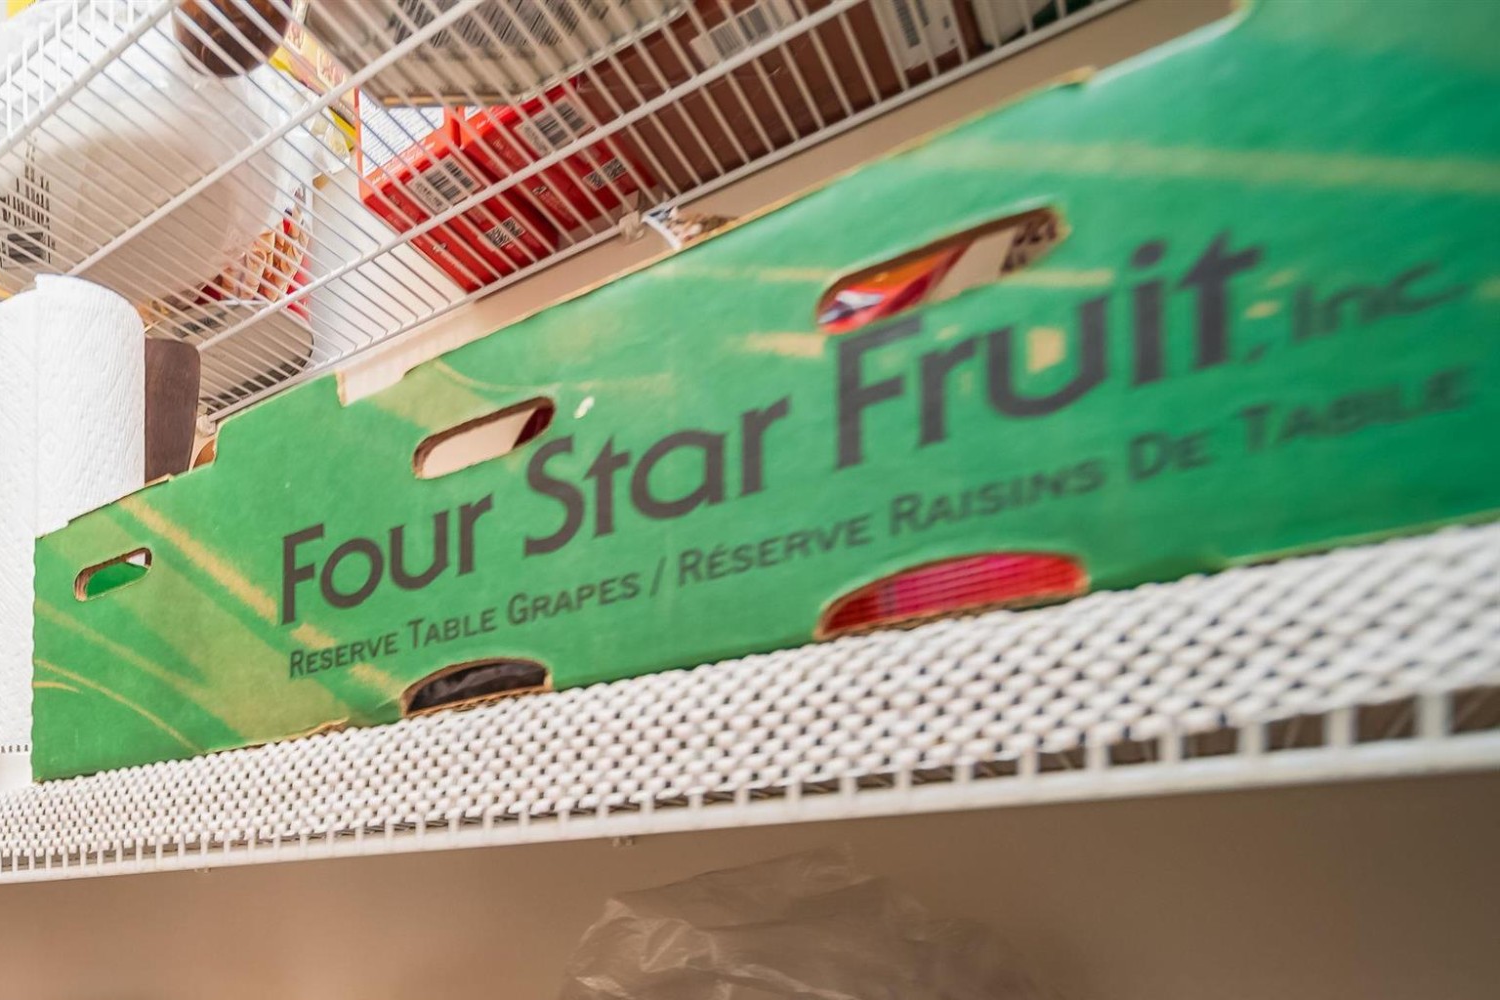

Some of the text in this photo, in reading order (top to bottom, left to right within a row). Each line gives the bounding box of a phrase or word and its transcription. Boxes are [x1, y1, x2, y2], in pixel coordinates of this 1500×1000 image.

[281, 491, 493, 625] Four
[523, 394, 792, 558] Star
[290, 633, 399, 680] RESERVE
[407, 608, 498, 651] TABLE
[507, 572, 643, 627] GRAPES
[888, 459, 1110, 541] RAISINS
